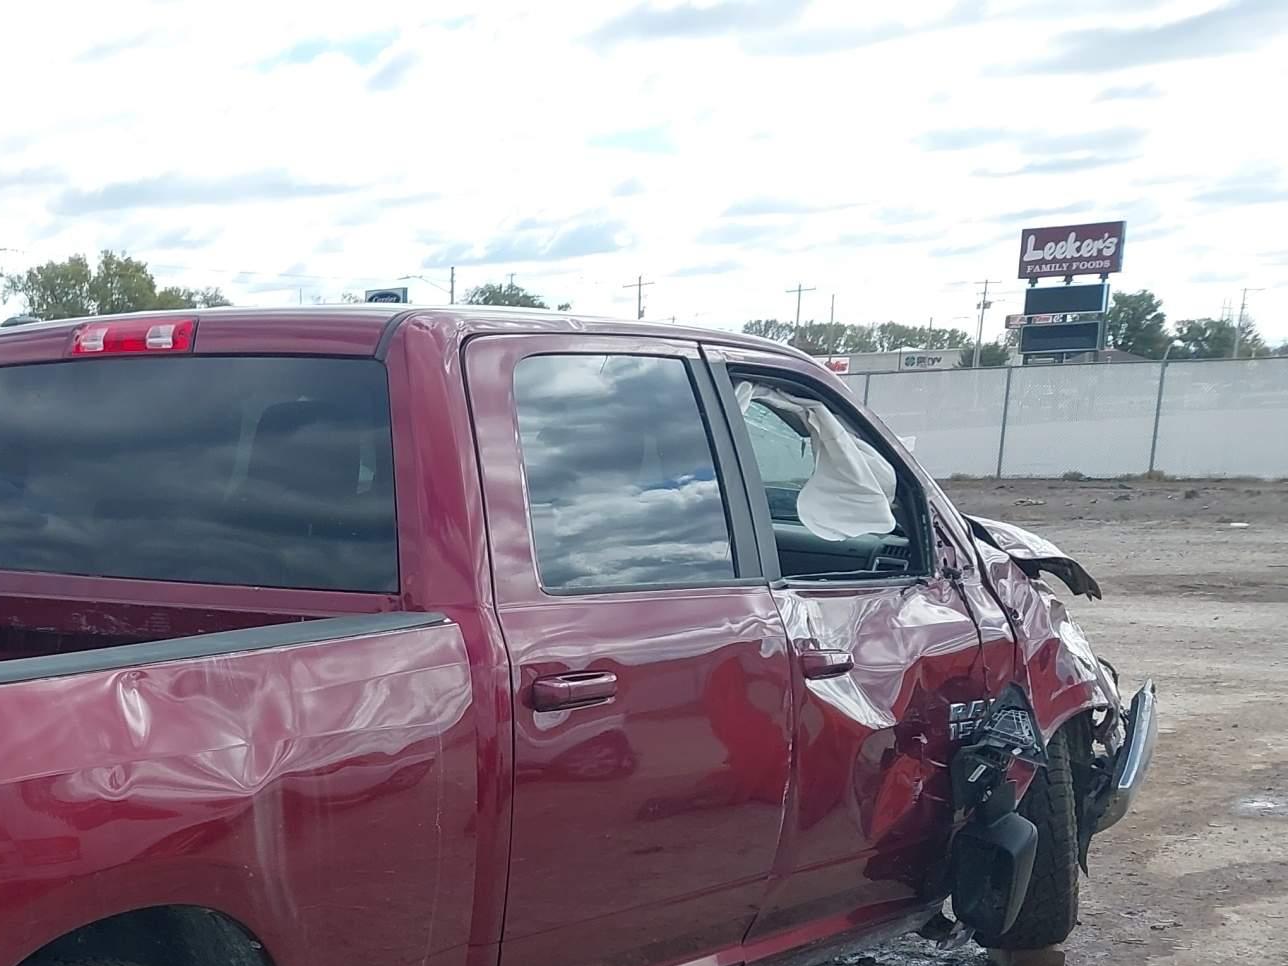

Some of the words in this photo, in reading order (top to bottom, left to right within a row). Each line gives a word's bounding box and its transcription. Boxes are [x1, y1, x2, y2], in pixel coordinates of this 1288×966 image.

[1023, 231, 1118, 261] Leeker's
[1026, 262, 1069, 273] FAMILY
[1072, 259, 1111, 270] FOODS
